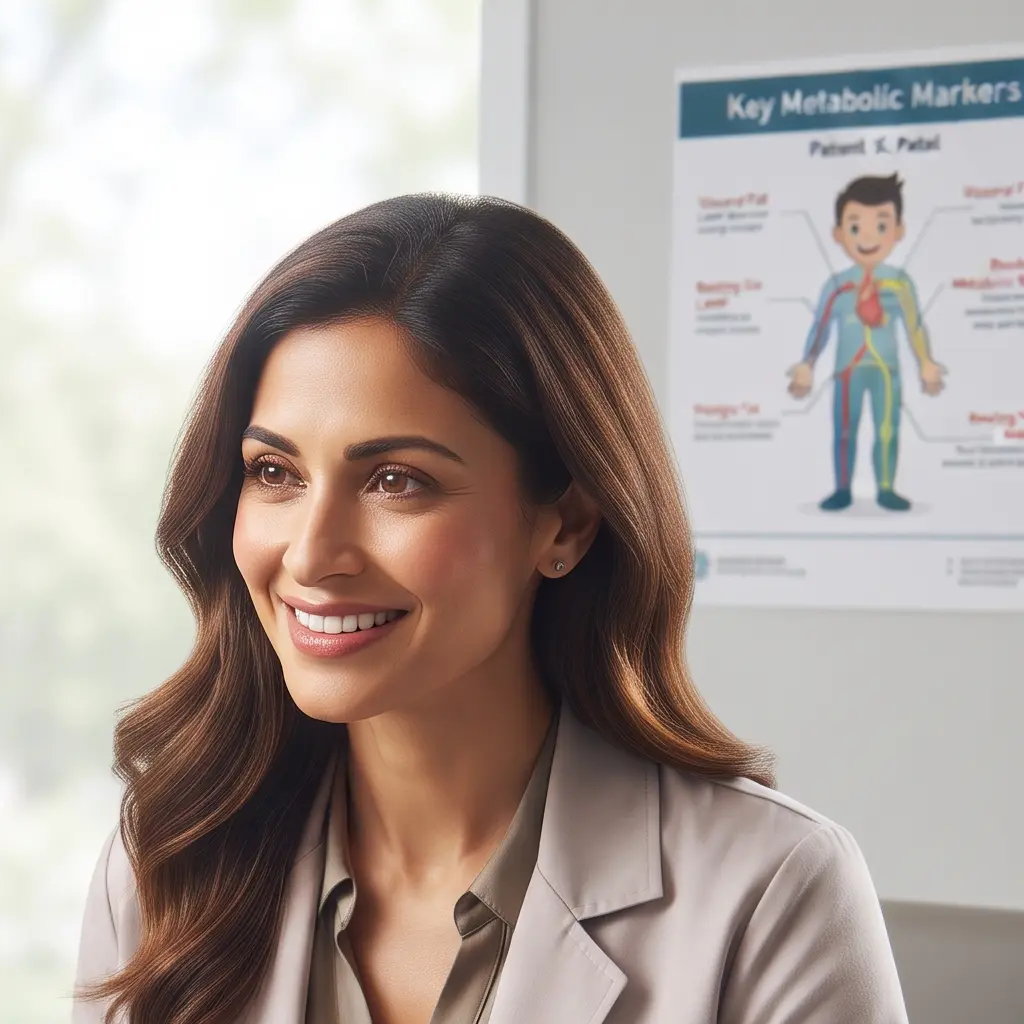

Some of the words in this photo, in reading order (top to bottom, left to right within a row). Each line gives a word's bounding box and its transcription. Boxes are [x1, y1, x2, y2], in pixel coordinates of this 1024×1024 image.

[727, 93, 775, 126] Key
[780, 83, 904, 117] Metabolic
[911, 77, 1023, 109] Markers
